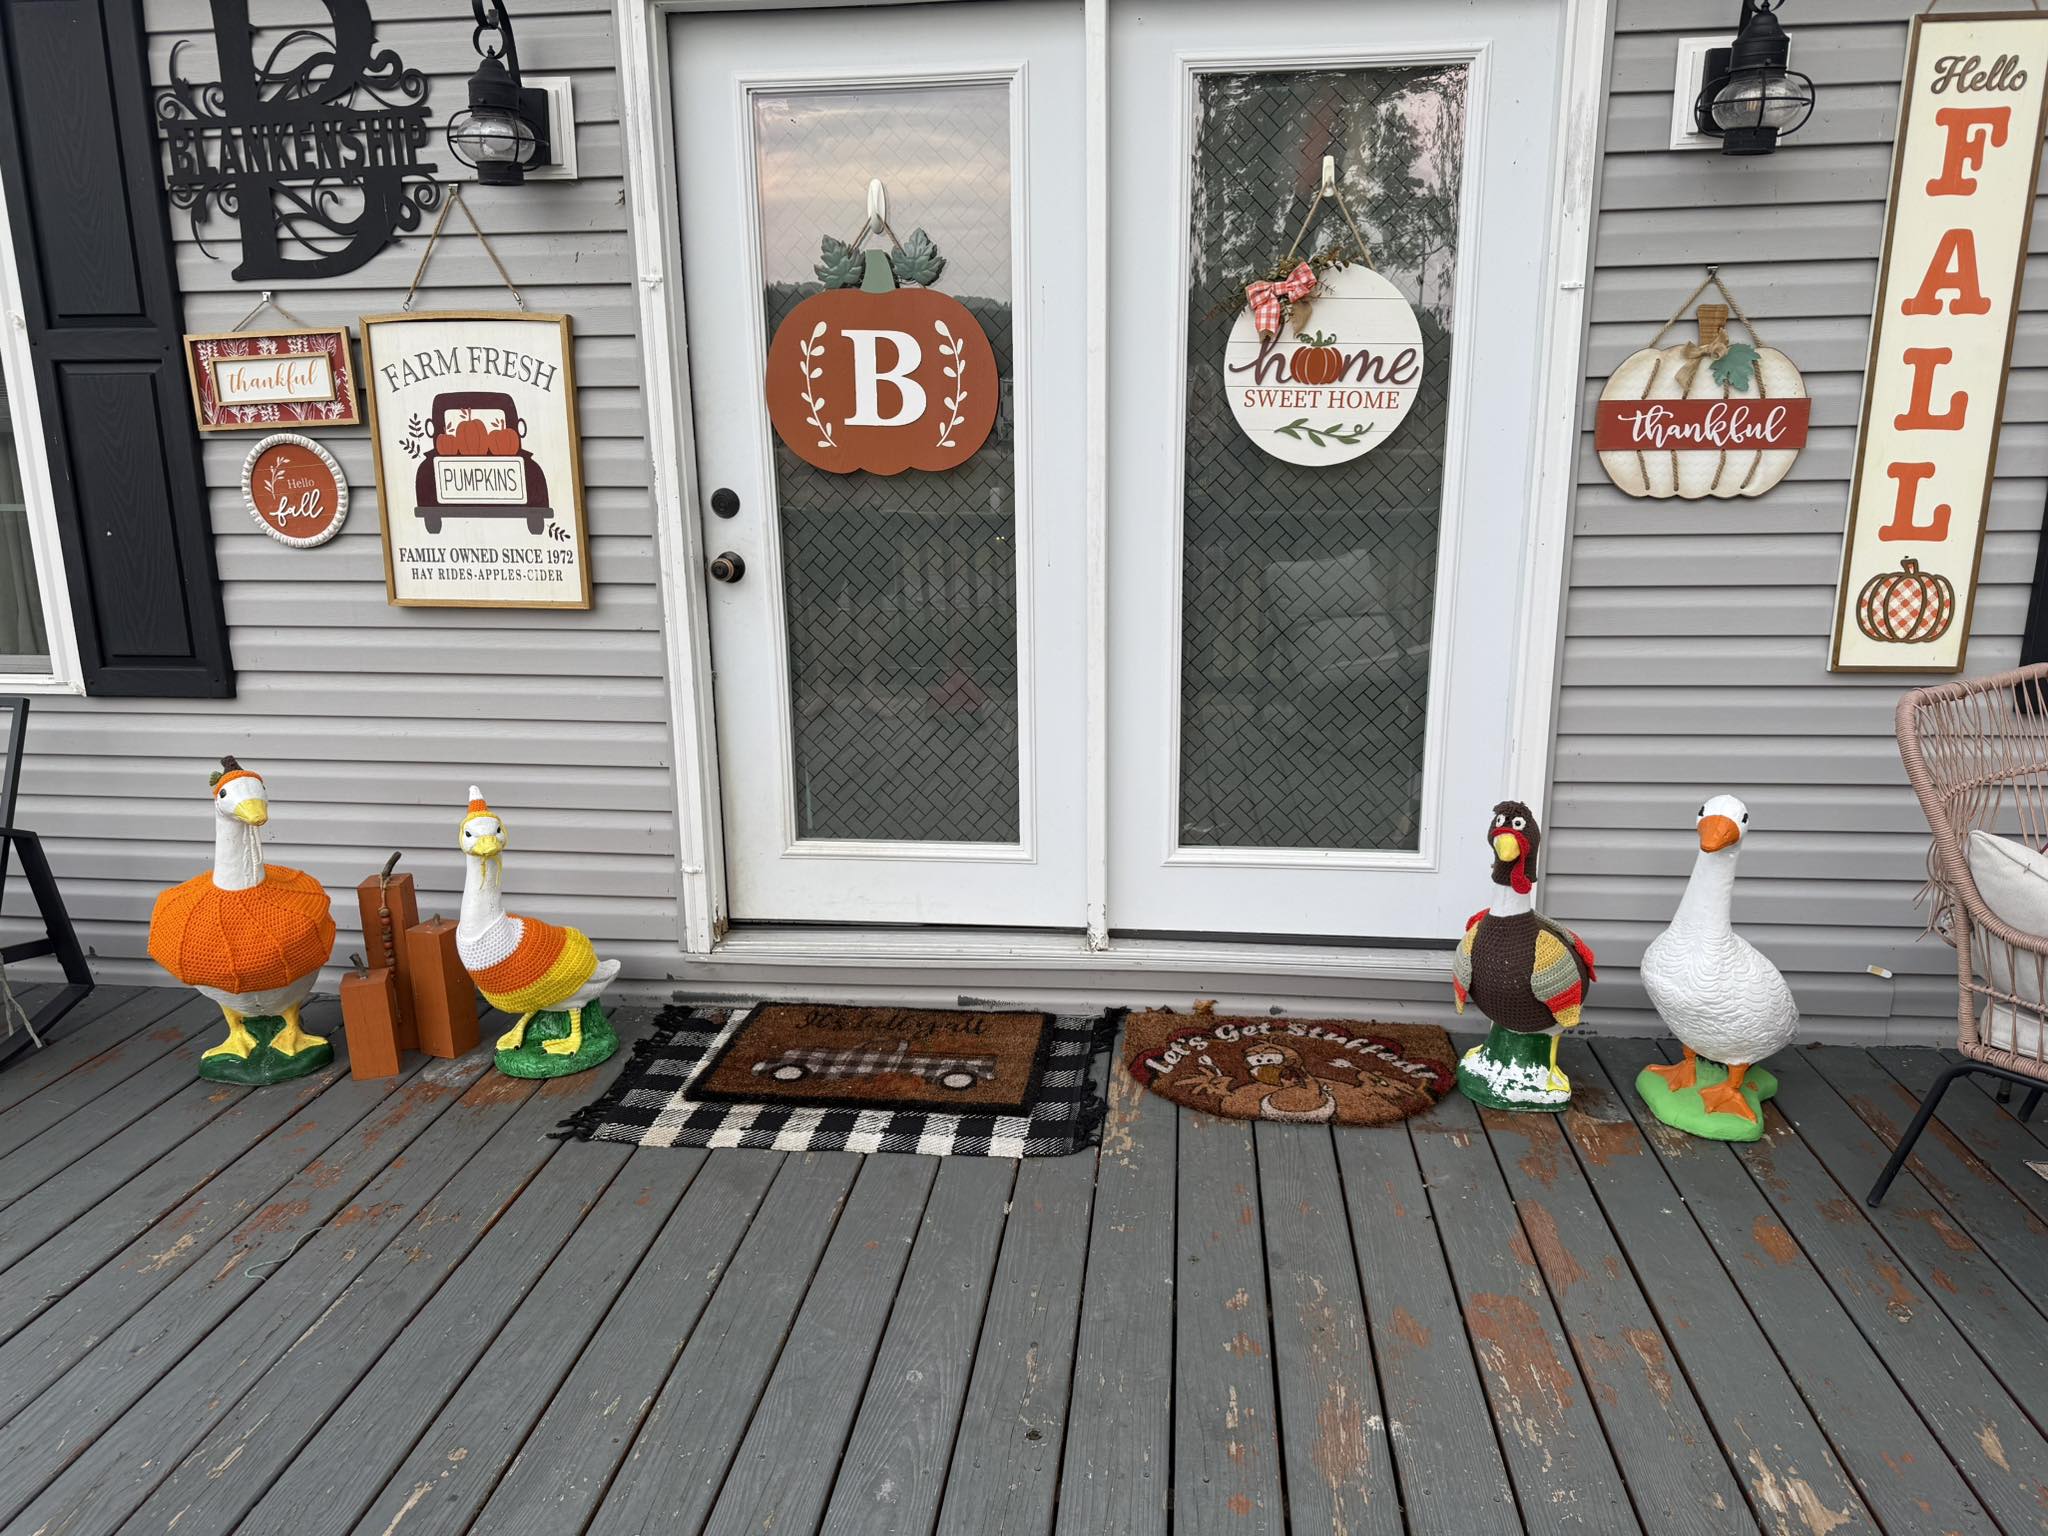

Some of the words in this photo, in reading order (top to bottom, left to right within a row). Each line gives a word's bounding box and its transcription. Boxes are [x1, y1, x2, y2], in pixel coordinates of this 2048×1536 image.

[1930, 54, 2028, 94] Hello
[167, 116, 430, 177] BLANKENSHIP
[1878, 106, 2011, 541] FALL
[228, 359, 318, 394] thankful
[380, 346, 462, 393] FARM
[466, 346, 558, 393] FRESH
[841, 329, 927, 427] B
[1243, 389, 1322, 408] SWEET
[1327, 390, 1400, 410] HOME
[1618, 402, 1787, 448] thankful
[287, 477, 315, 490] Hello
[443, 467, 517, 492] PUMPKINS
[269, 488, 324, 527] fall
[399, 547, 447, 563] FAMILY
[450, 547, 499, 564] OWNED
[502, 548, 543, 565] SINCE
[546, 549, 574, 565] 1972
[411, 567, 434, 581] HAY
[1145, 1036, 1209, 1074] Let's
[1214, 1021, 1271, 1042] Get
